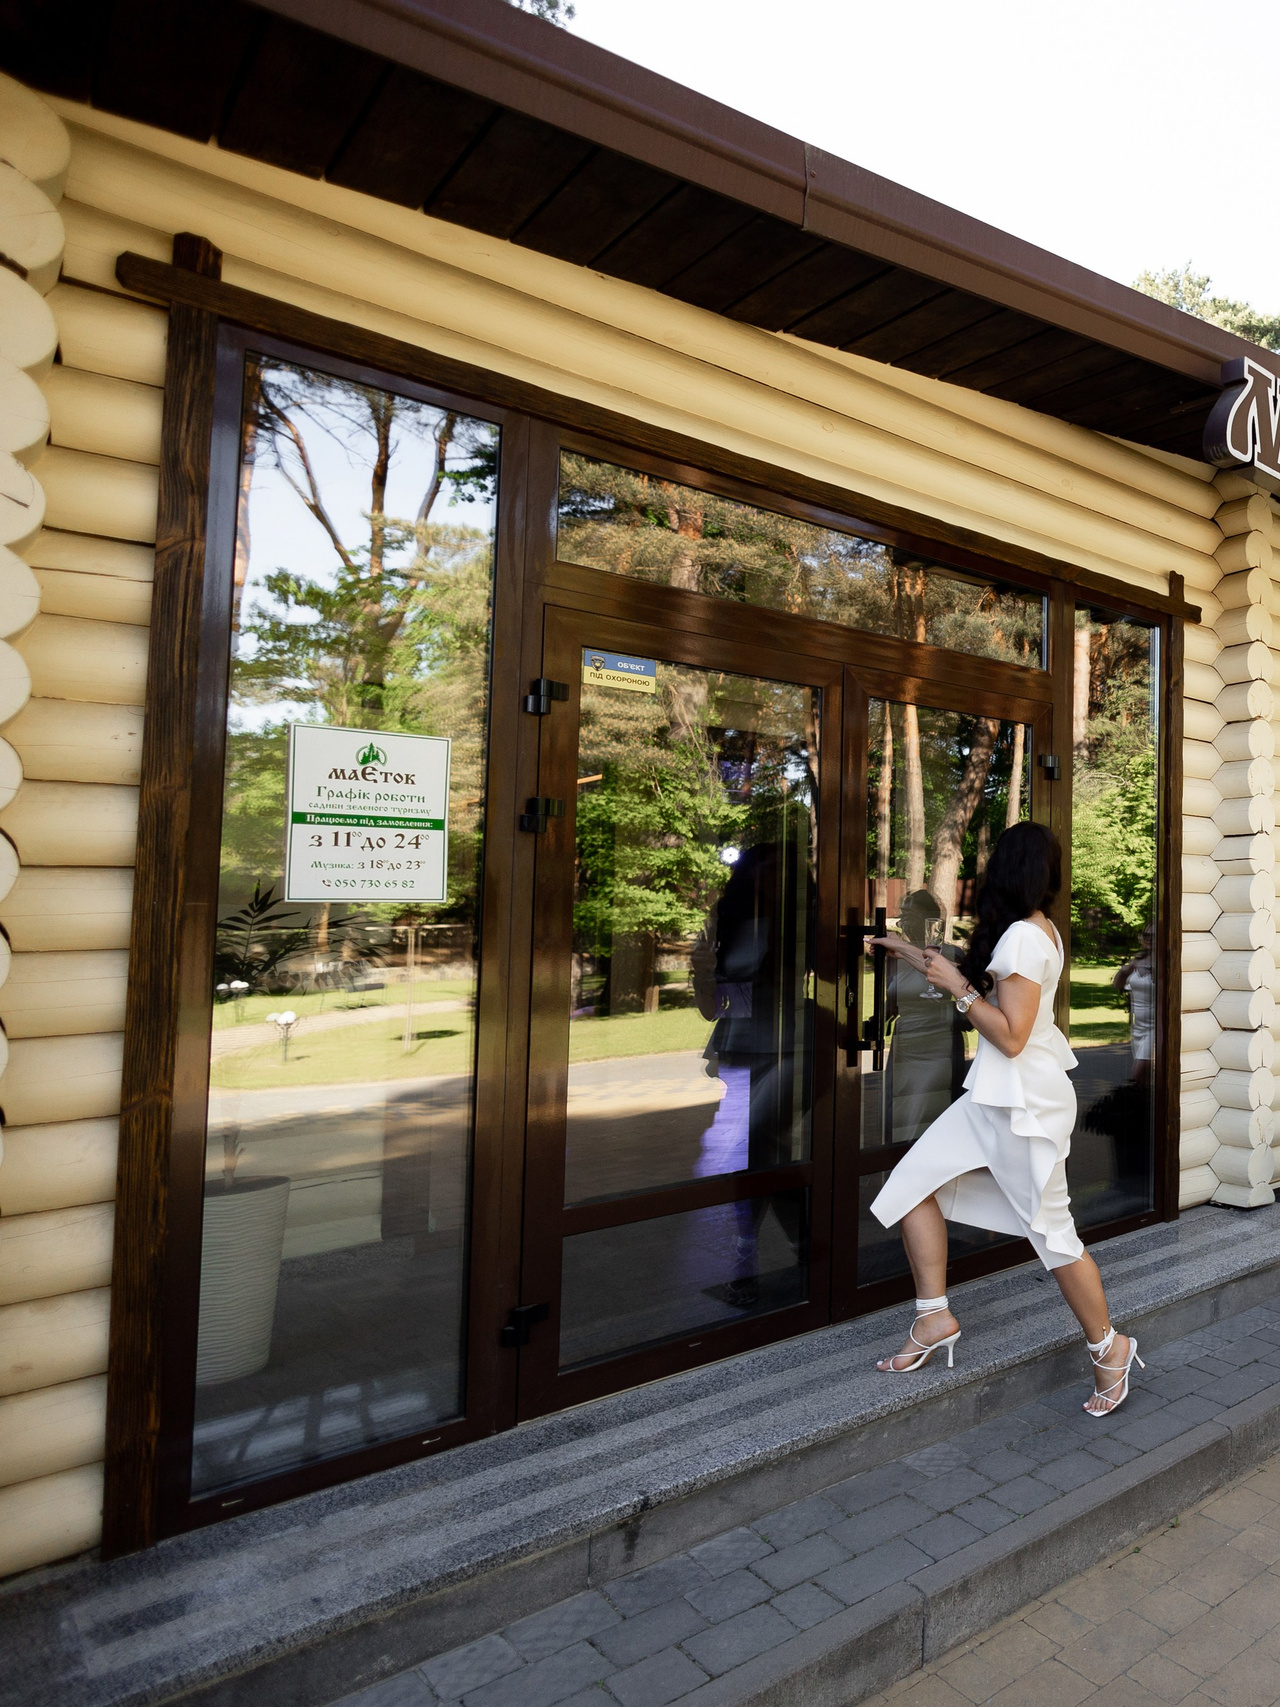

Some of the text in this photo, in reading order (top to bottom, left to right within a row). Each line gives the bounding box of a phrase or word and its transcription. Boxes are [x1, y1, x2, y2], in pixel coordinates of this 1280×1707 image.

[589, 671, 650, 687] ПІД ОХОРОНОЮ
[316, 786, 425, 803] Графік роботи
[345, 804, 388, 812] зеленого
[390, 806, 432, 816] туризму
[306, 814, 433, 828] Працюємо під замовлення:
[361, 837, 386, 851] до
[311, 861, 354, 870] Музика:
[387, 862, 402, 871] до
[334, 879, 415, 889] 050 730 65 82
